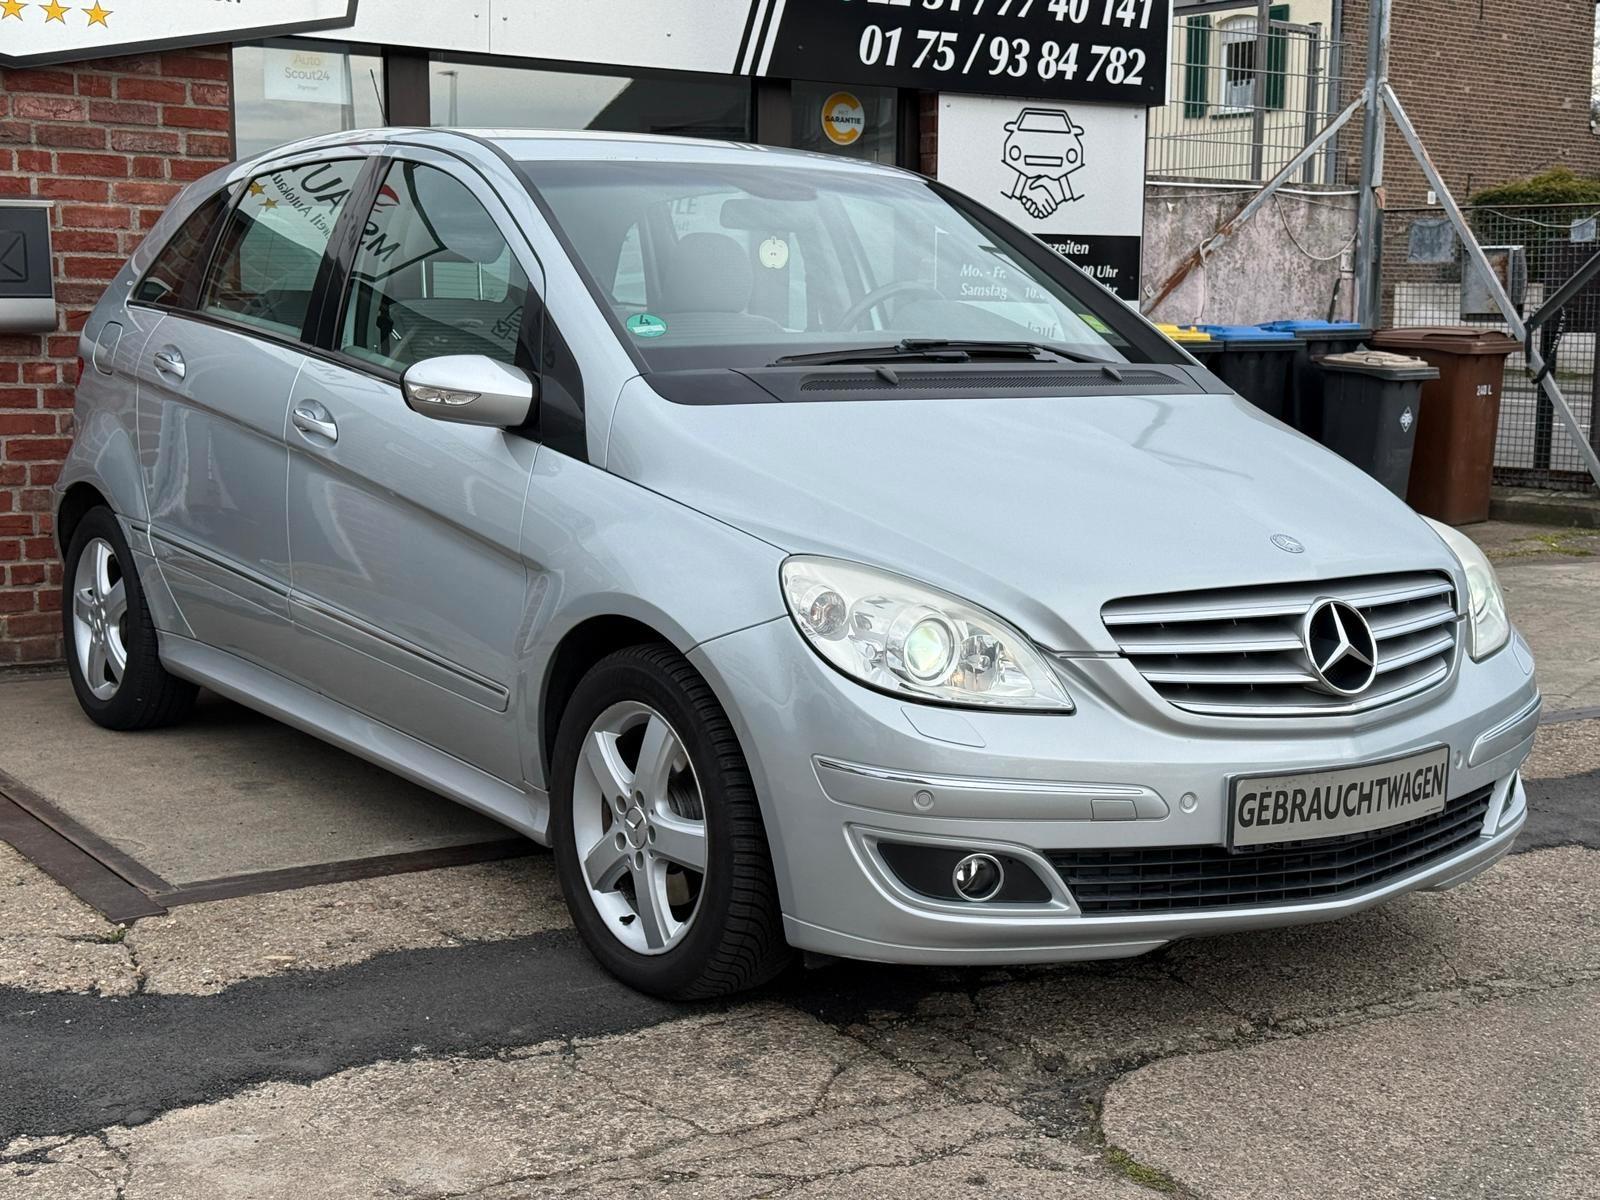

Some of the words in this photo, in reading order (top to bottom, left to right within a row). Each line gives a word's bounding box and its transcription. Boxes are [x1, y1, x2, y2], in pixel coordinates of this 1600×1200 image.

[859, 25, 902, 67] 01
[912, 30, 958, 71] 75
[962, 34, 985, 74] /
[988, 37, 1030, 77] 93
[1037, 41, 1079, 80] 84
[1086, 45, 1147, 86] 782
[284, 67, 330, 81] Scout24
[825, 115, 861, 124] GARANTIE
[1047, 240, 1090, 255] zeiten
[960, 264, 984, 278] Mo.
[993, 267, 1007, 279] Fr.
[1096, 265, 1119, 278] Uhr
[960, 283, 1008, 299] Samstag
[1237, 762, 1446, 829] GEBRAUCHTWAGEN
